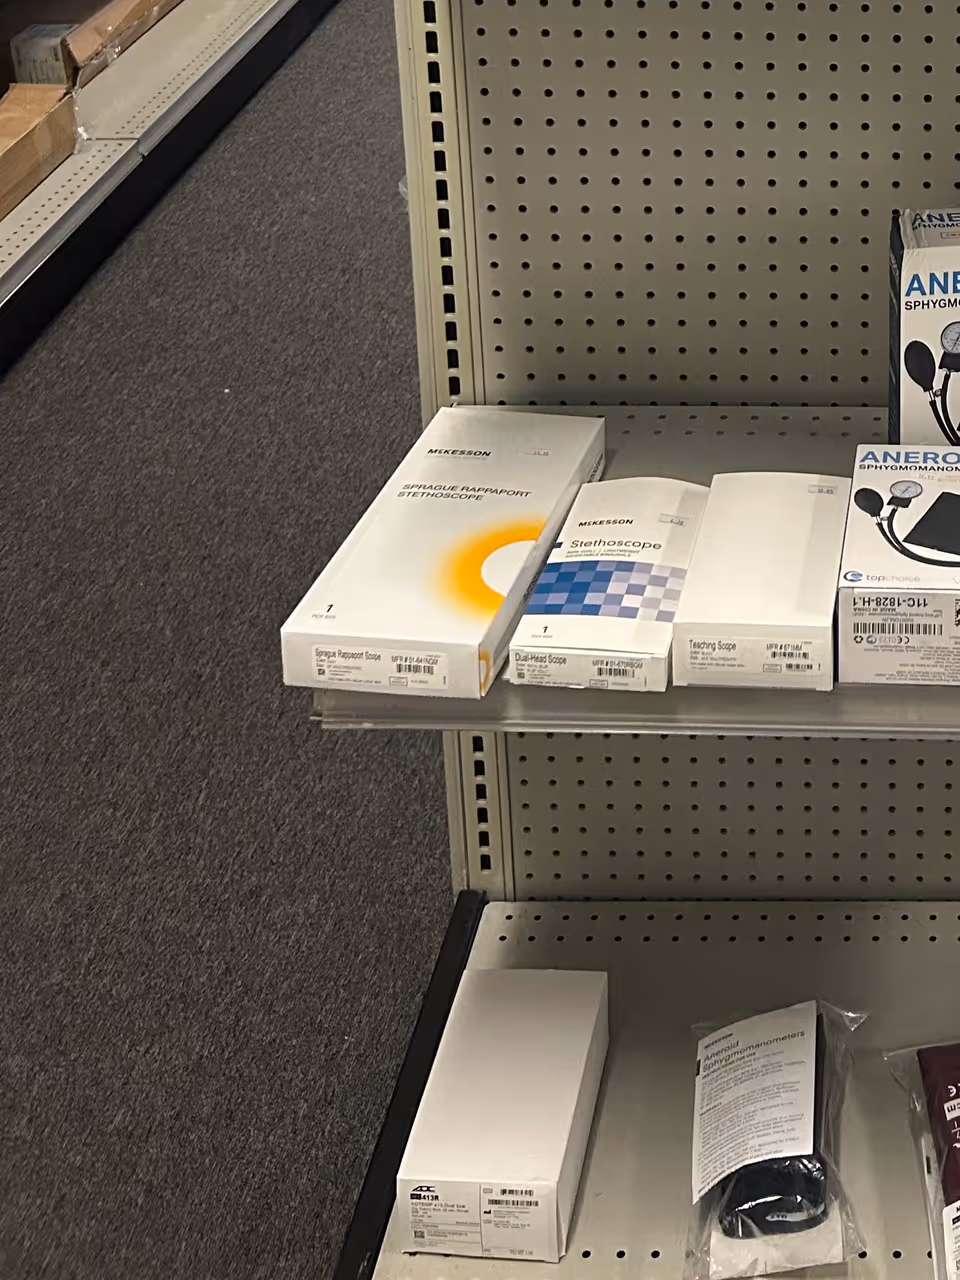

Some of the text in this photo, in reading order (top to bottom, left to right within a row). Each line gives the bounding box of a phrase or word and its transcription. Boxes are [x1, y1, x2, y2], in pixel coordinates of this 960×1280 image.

[397, 491, 485, 501] STETHOSCOPE
[402, 483, 532, 498] SPRAGUE RAPPAPORT
[570, 539, 662, 551] Stethoscope
[853, 597, 928, 607] 11C-1828-H.1
[689, 639, 736, 652] Teaching Scope
[315, 648, 381, 662] Sprague Rappaport Scope
[515, 652, 567, 666] Dual-Head Scope
[704, 1040, 740, 1063] Aneroid
